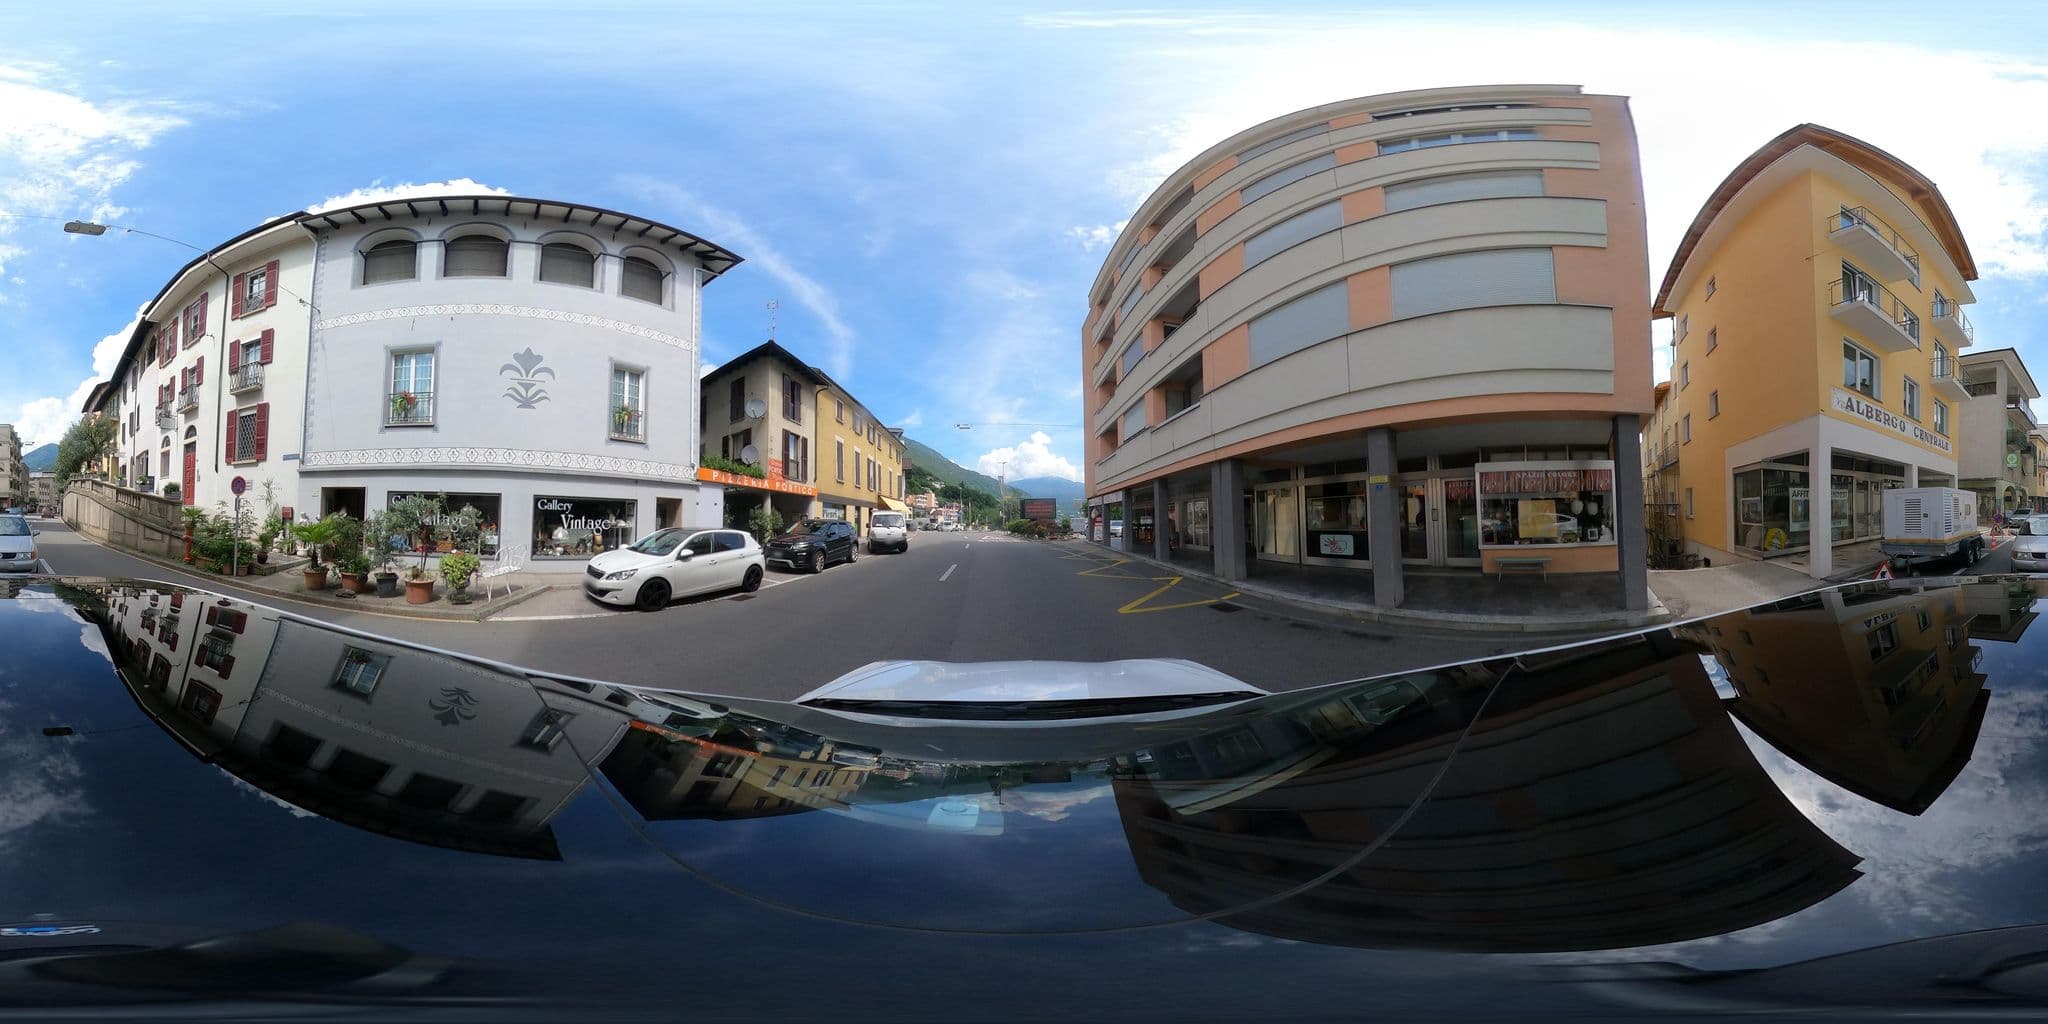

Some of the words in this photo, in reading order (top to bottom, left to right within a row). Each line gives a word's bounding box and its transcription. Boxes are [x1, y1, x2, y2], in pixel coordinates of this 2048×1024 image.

[1845, 396, 1906, 433] ALBERGO
[1913, 426, 1950, 452] CENTRALE
[711, 471, 769, 489] PIZZERIA
[775, 482, 813, 496] PORTICO
[537, 499, 573, 514] Gallery
[560, 513, 611, 535] Vintage
